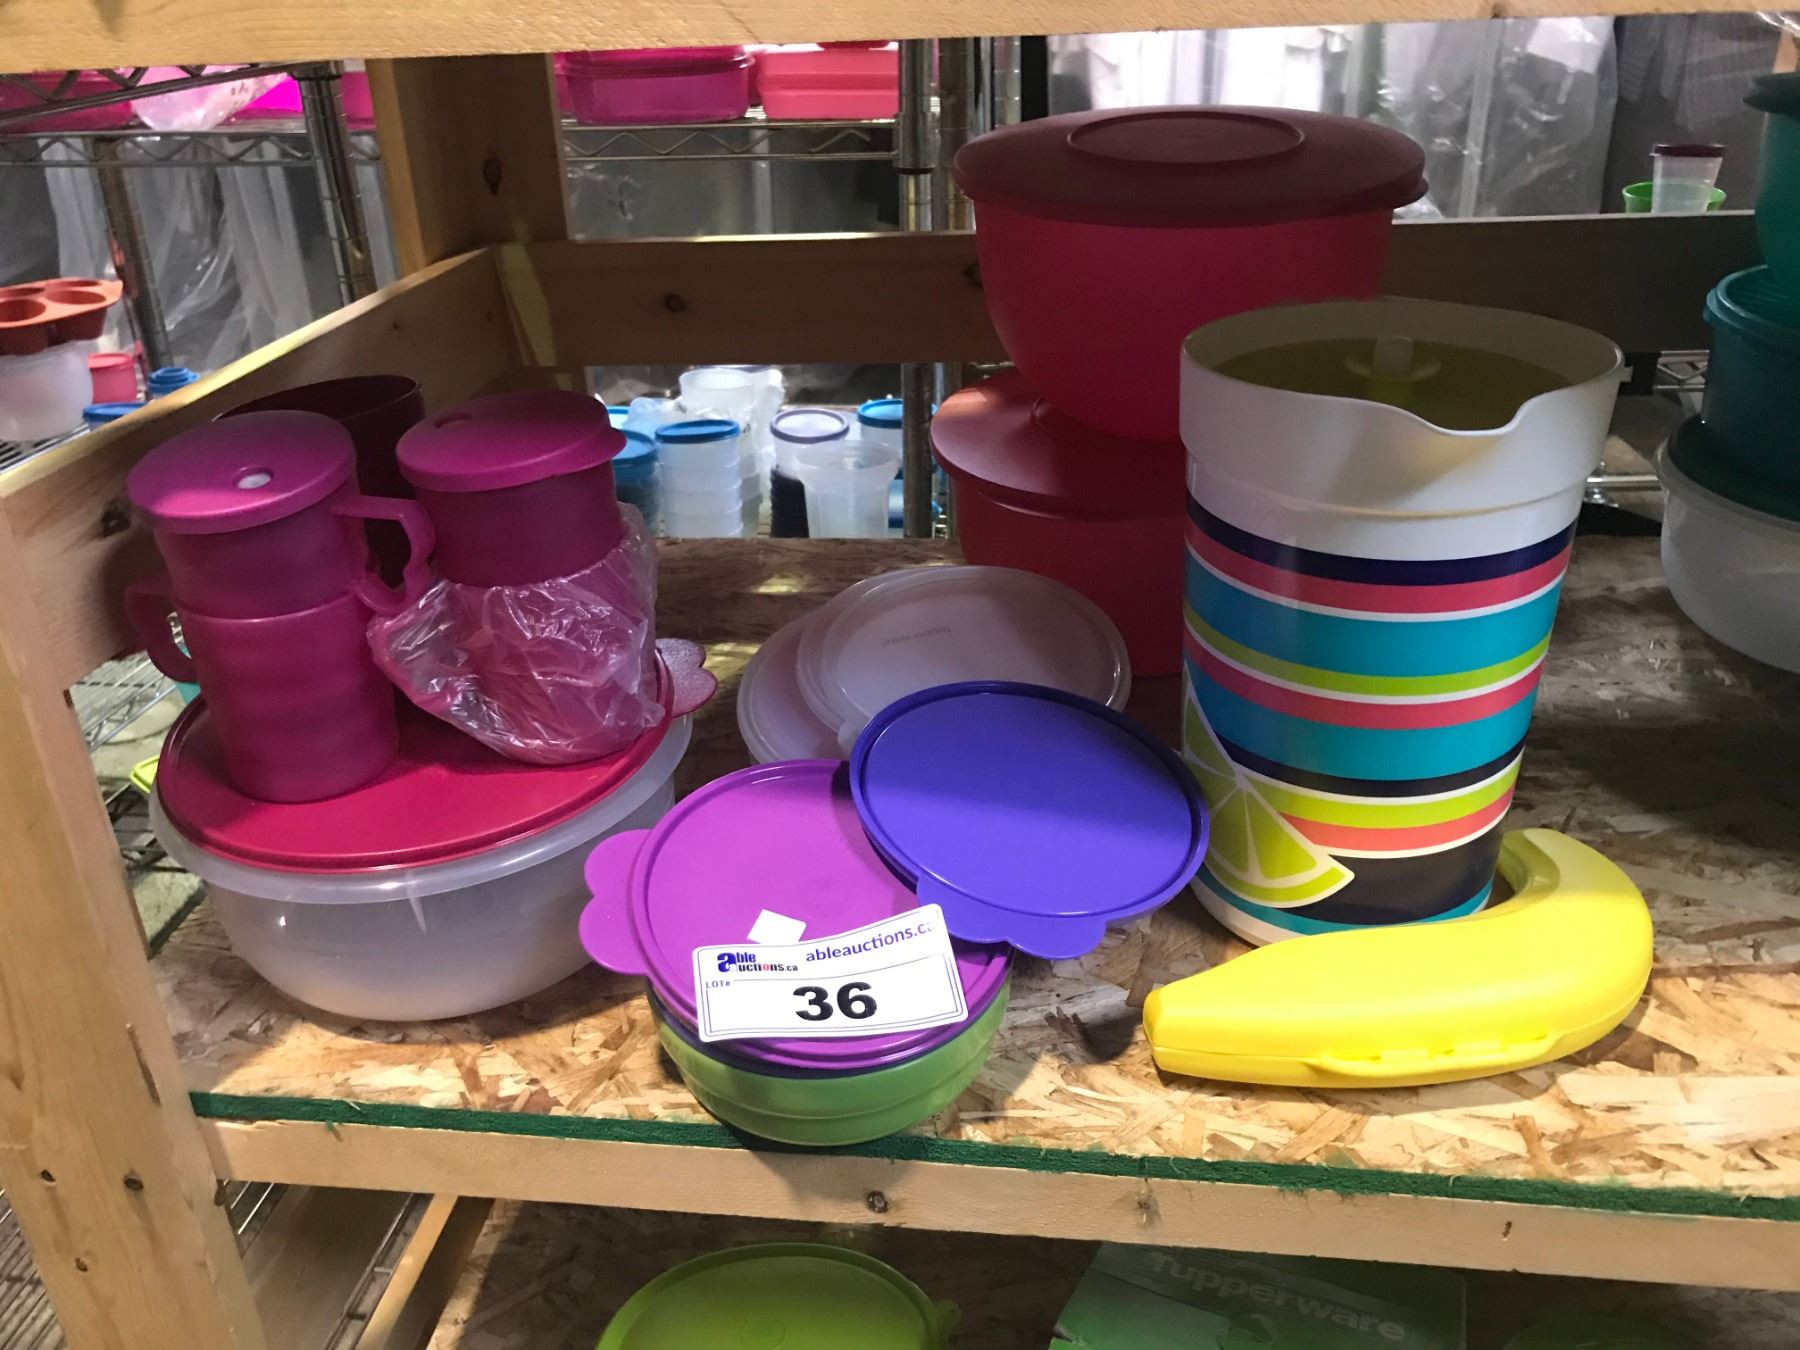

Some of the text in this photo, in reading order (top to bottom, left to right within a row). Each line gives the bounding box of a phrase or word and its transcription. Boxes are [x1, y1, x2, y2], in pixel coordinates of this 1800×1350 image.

[705, 980, 731, 989] LOT#
[792, 981, 878, 1021] 36
[1149, 1250, 1406, 1341] Tupperware
